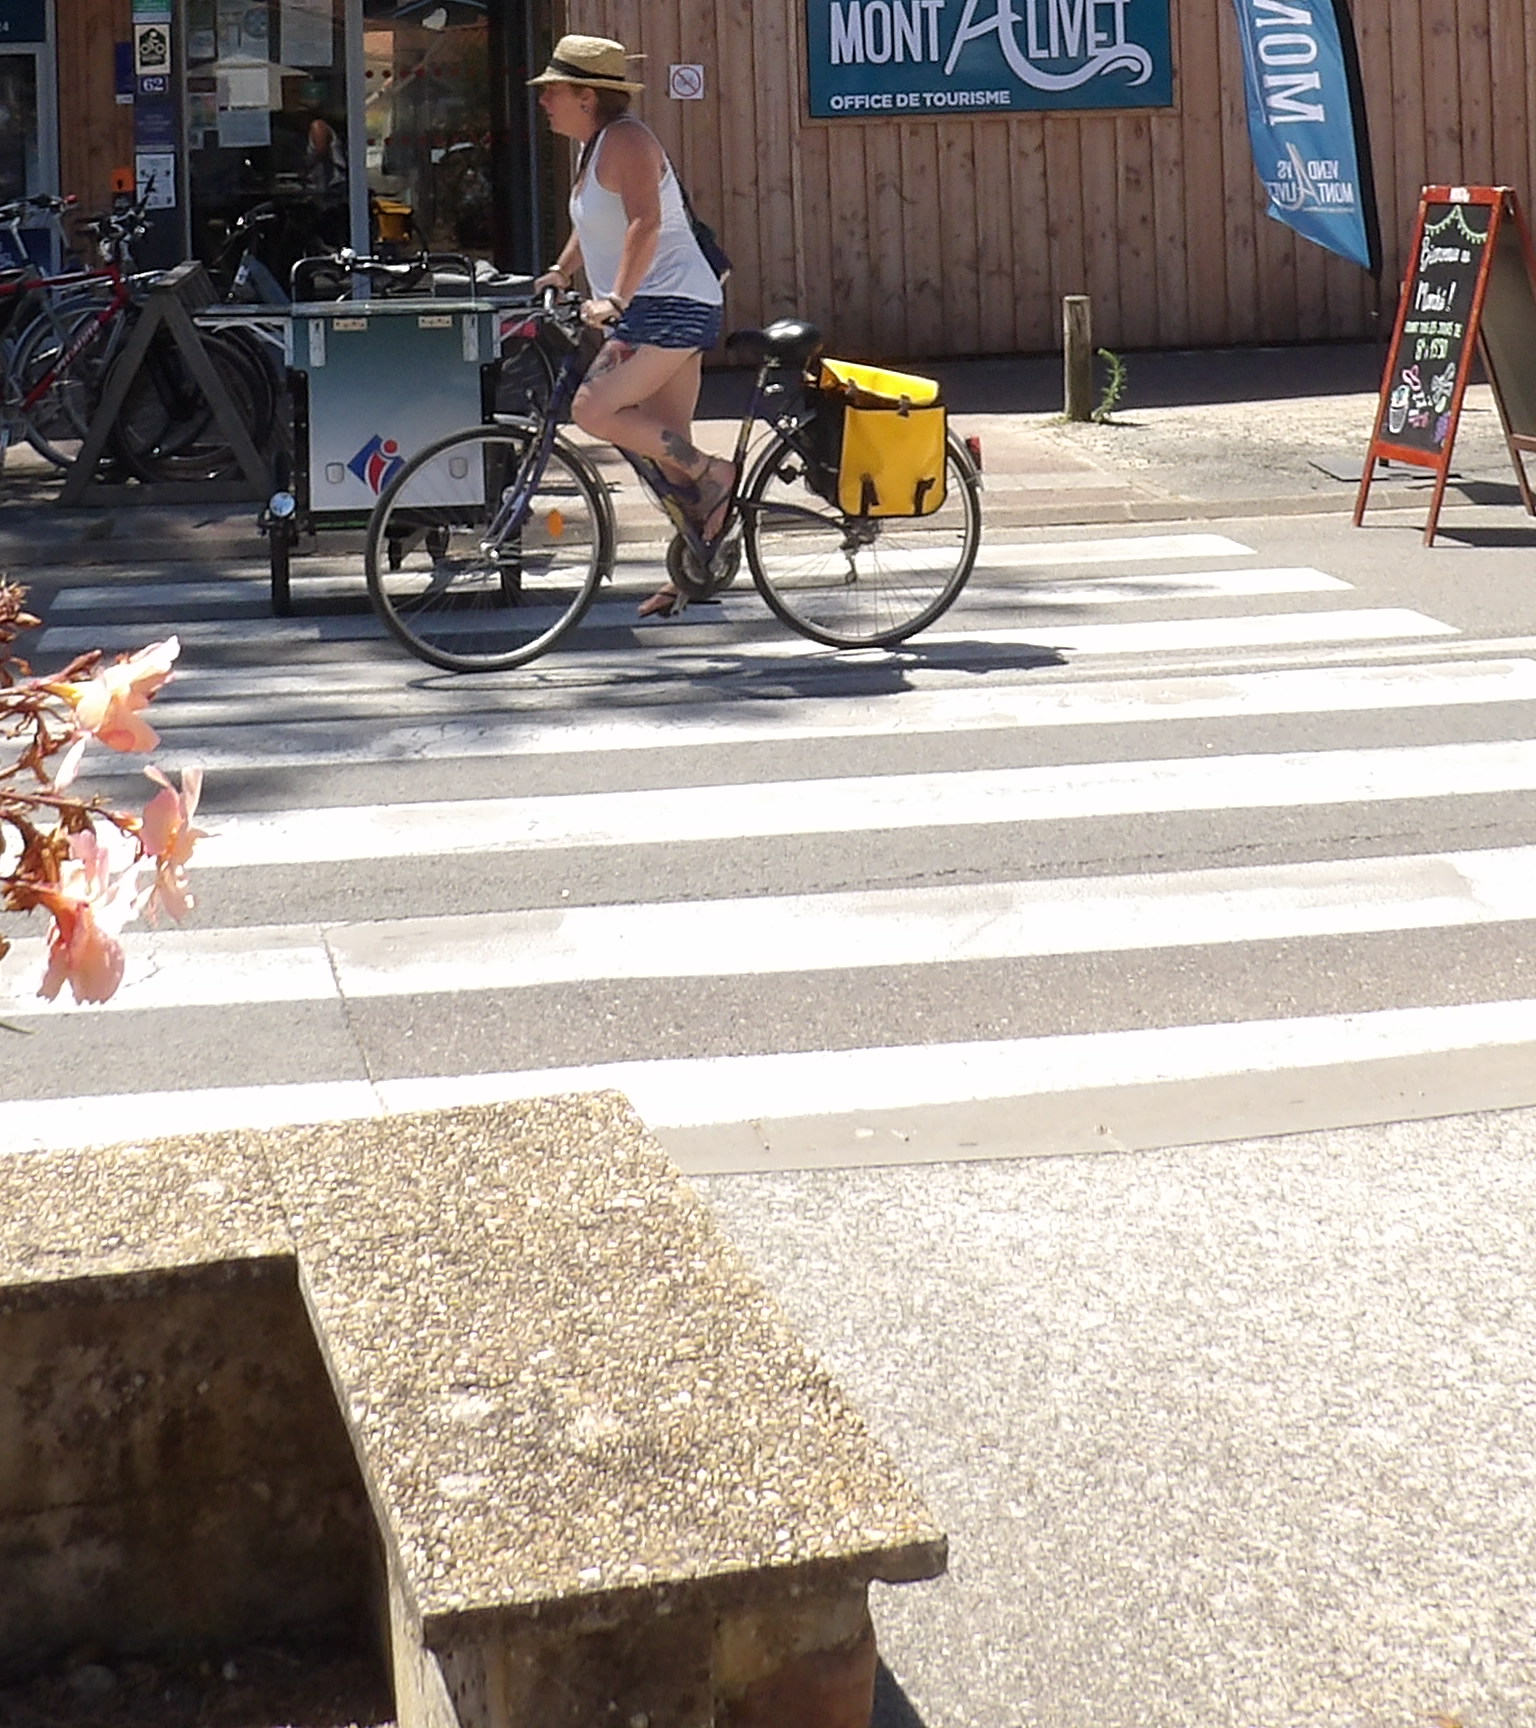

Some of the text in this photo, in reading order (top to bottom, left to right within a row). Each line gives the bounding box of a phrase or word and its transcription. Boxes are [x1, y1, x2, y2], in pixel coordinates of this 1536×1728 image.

[143, 77, 164, 91] 62
[829, 90, 1011, 111] OFFICE DE TOURISME
